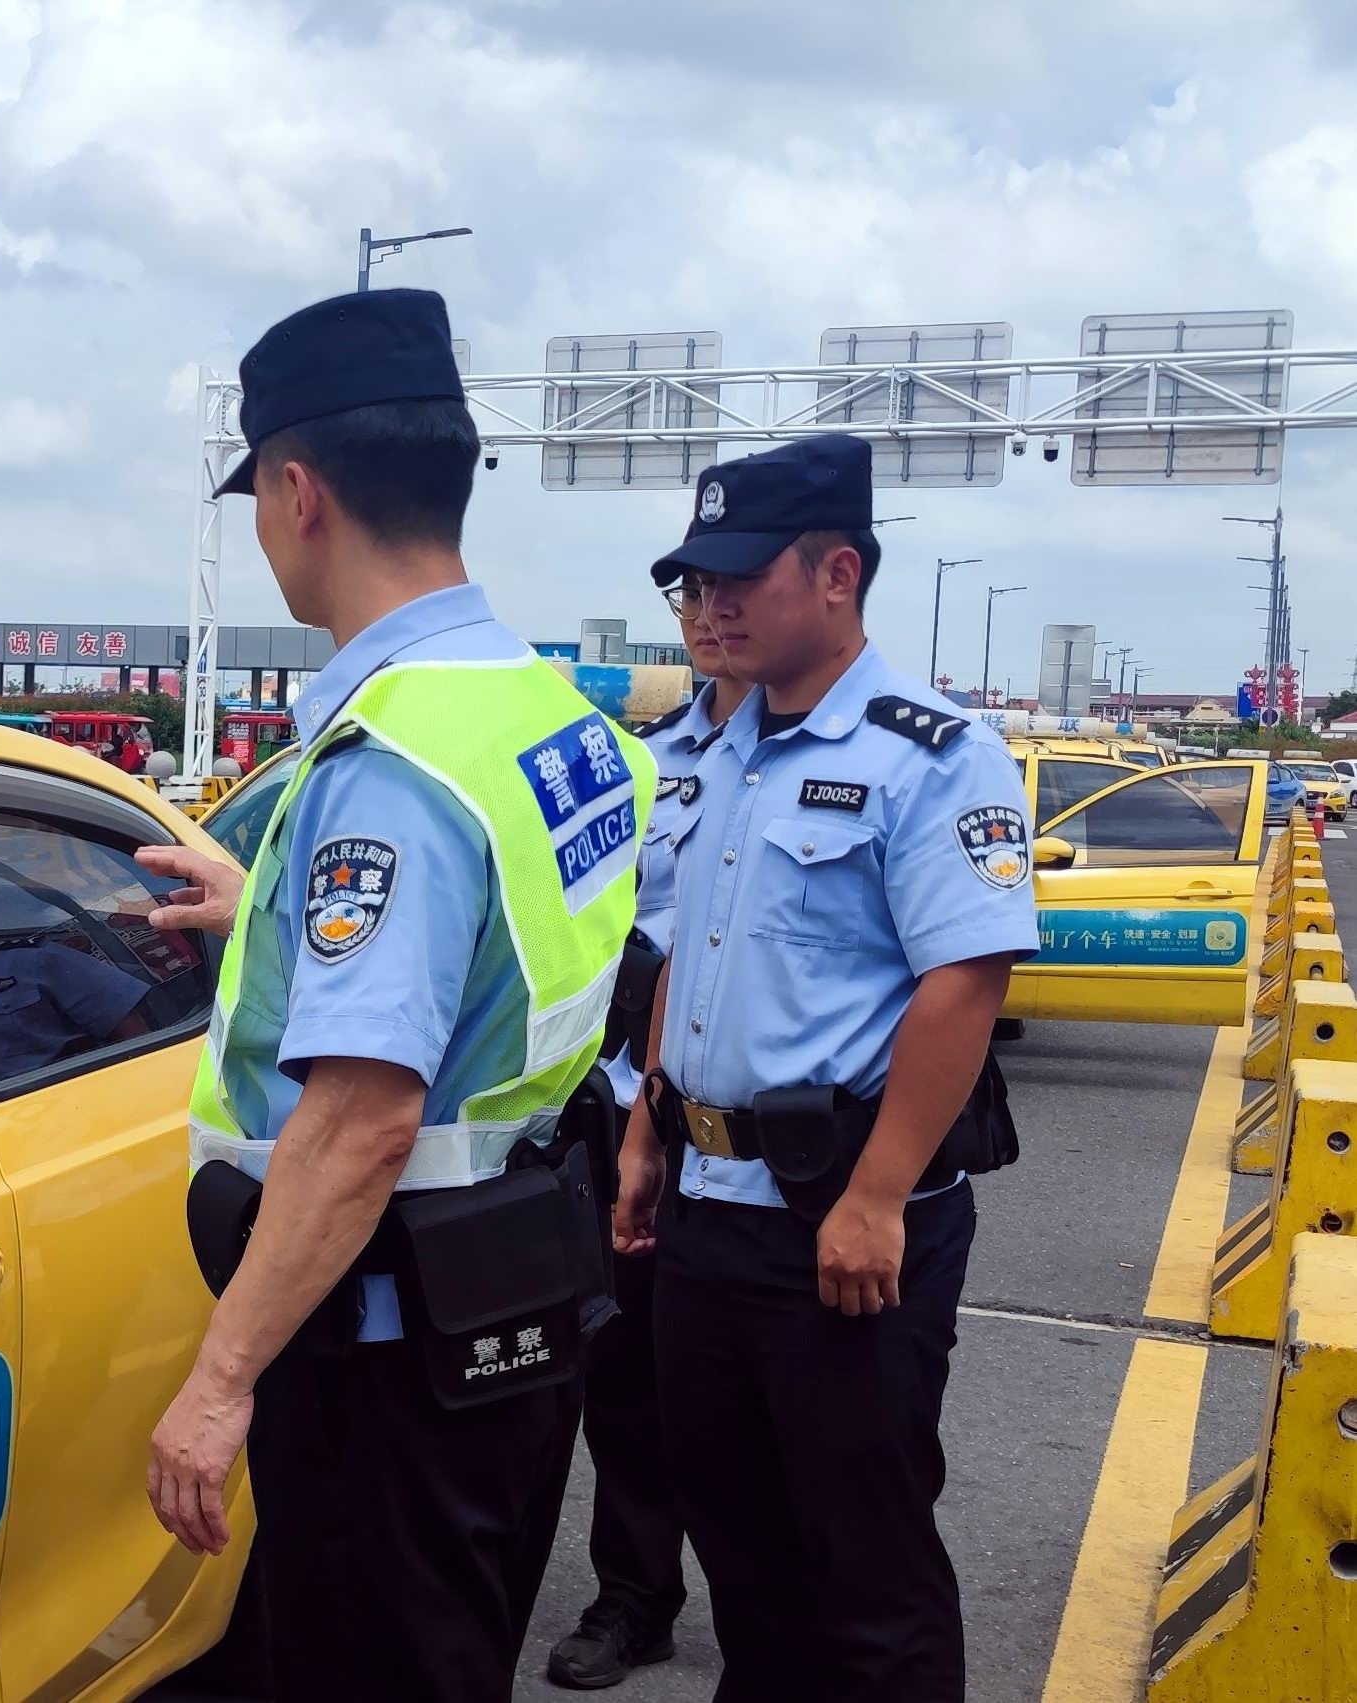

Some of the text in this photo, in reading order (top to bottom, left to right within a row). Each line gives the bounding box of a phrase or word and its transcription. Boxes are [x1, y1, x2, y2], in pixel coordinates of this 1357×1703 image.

[8, 630, 60, 656] 诚信
[77, 631, 126, 658] 友善
[533, 723, 620, 814] 警察
[805, 784, 862, 805] TJ0052
[312, 842, 395, 875] 中华人民共和国
[564, 805, 632, 880] POLICE
[473, 1326, 543, 1365] 警察
[465, 1348, 551, 1380] POLICE
